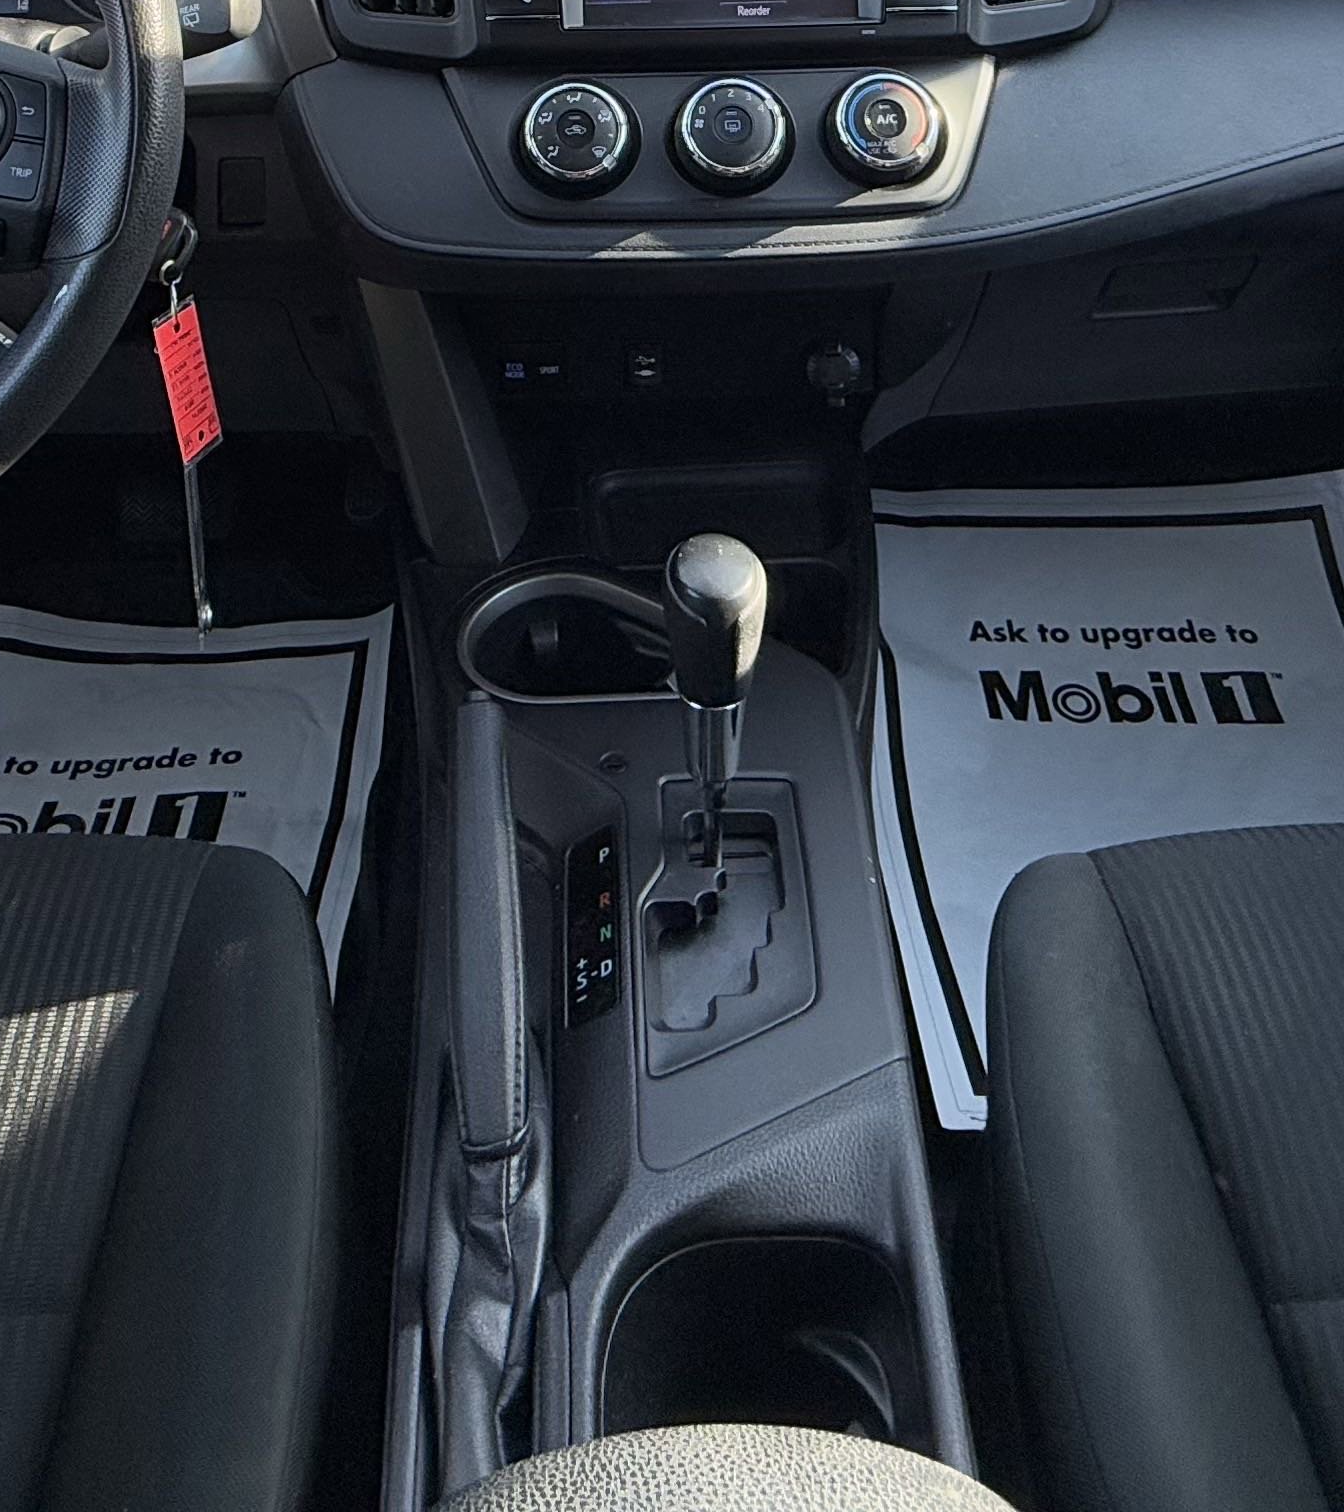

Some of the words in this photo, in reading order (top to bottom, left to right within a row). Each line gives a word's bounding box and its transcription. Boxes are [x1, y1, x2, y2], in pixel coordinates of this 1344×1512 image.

[737, 5, 771, 17] Reorder
[727, 89, 736, 98] 2
[745, 92, 753, 101] 3
[757, 103, 765, 113] 4
[876, 113, 898, 125] A/C
[9, 166, 33, 178] TRIP
[969, 619, 1029, 643] Ask
[1037, 623, 1069, 643] to
[1080, 619, 1217, 650] upgrade
[1225, 624, 1259, 644] to
[978, 670, 1198, 724] Mobil
[3, 756, 39, 776] to
[50, 747, 198, 781] upgrade
[209, 747, 243, 766] to
[599, 846, 610, 864] P
[599, 891, 610, 908] R
[599, 924, 612, 942] N
